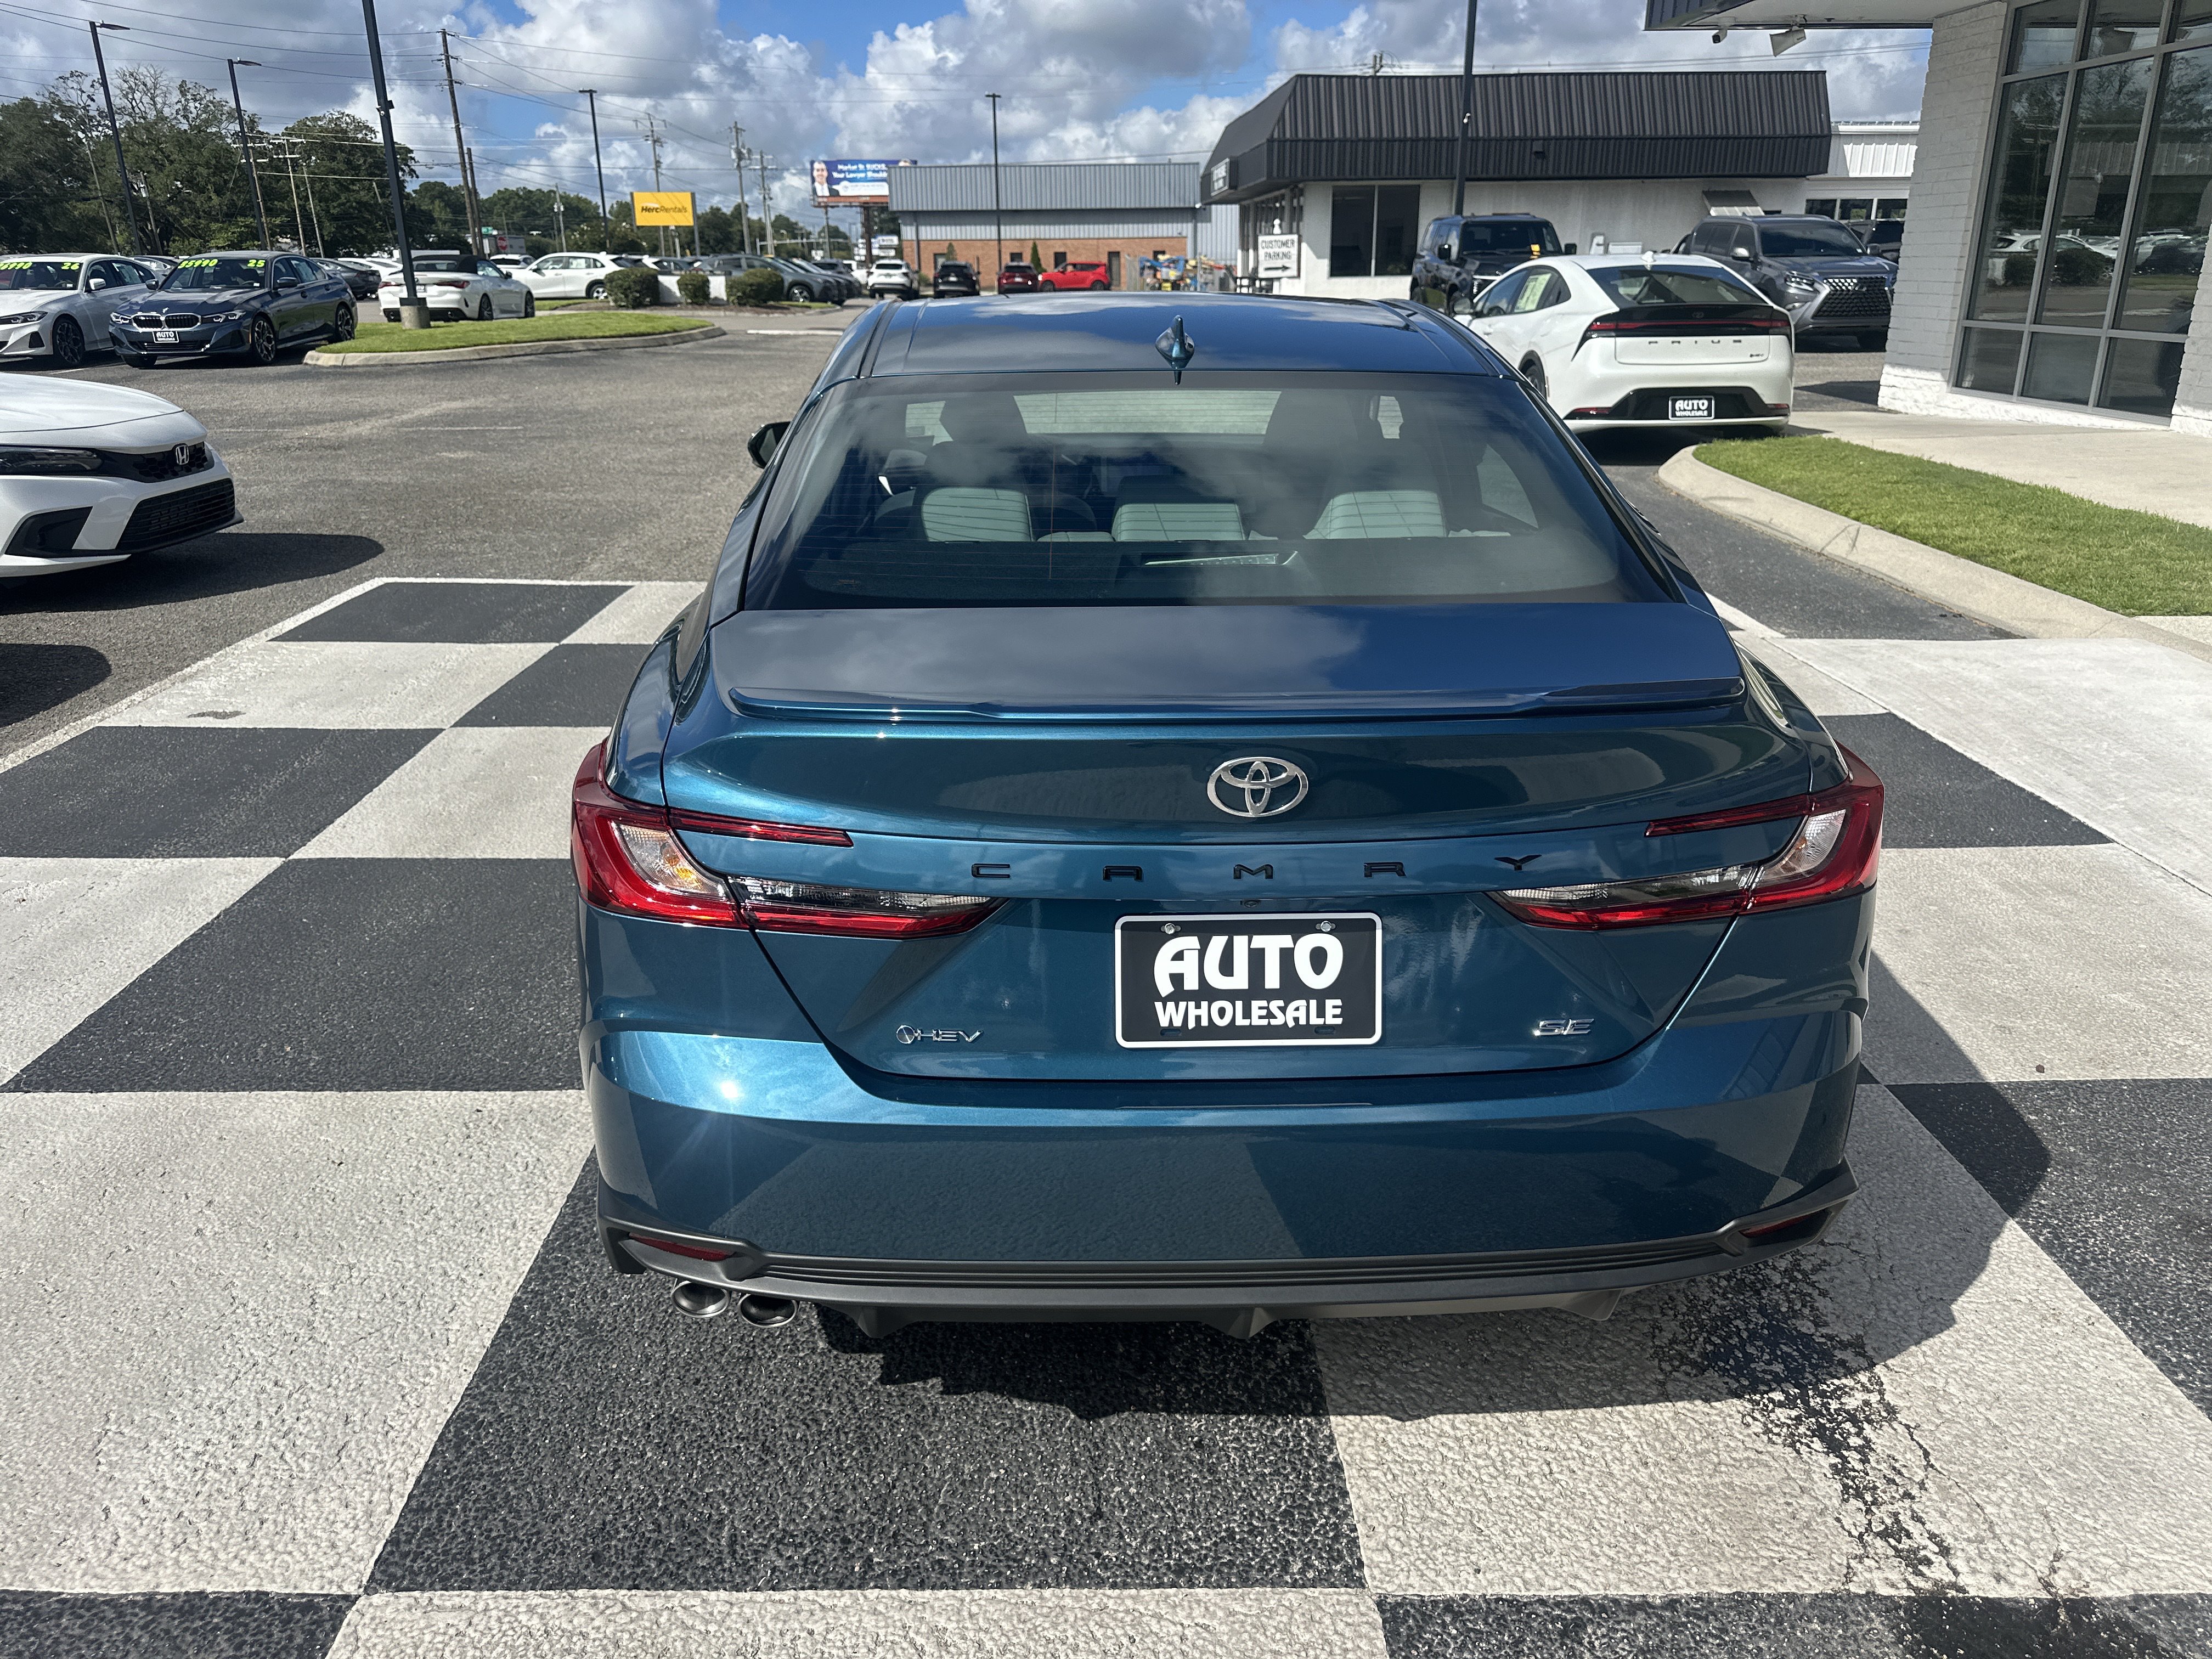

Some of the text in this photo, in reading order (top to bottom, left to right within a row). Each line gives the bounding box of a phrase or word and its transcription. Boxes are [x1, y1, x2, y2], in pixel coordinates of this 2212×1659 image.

[1260, 239, 1295, 249] CUSTOMER
[1264, 251, 1291, 261] PARKING
[1675, 399, 1708, 411] AUTO
[972, 854, 1542, 881] CAMRY
[1154, 933, 1344, 997] AUTO
[1154, 998, 1344, 1030] WHOLESALE
[916, 1028, 984, 1042] HEV
[1534, 1018, 1595, 1036] SE
